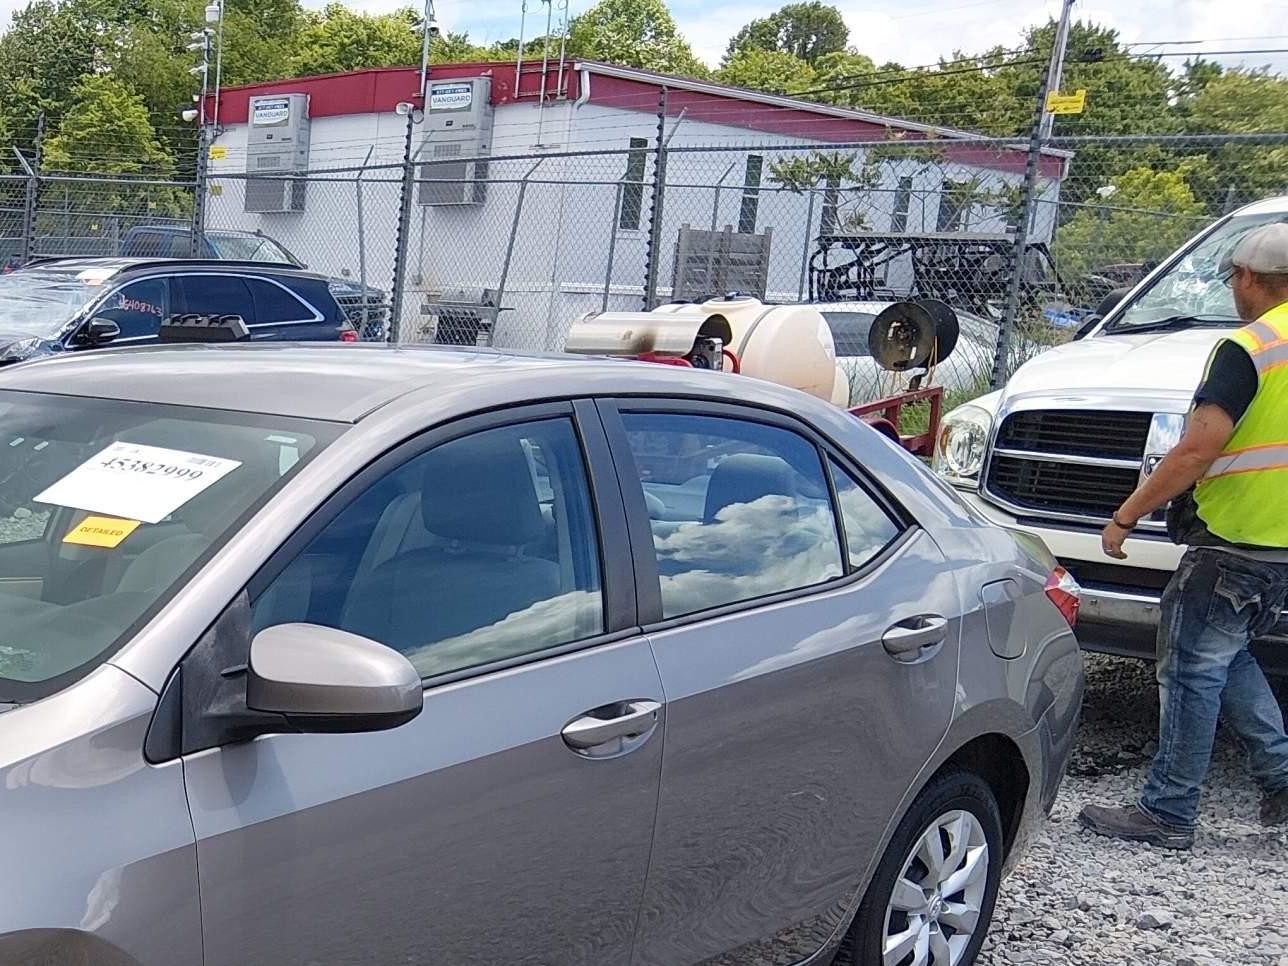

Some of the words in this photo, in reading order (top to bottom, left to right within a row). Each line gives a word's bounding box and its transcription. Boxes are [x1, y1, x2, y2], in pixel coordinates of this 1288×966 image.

[432, 94, 471, 103] VANGUARD
[255, 110, 288, 118] VANGUARD
[100, 456, 204, 482] 45382999
[80, 526, 124, 536] DETAILED
